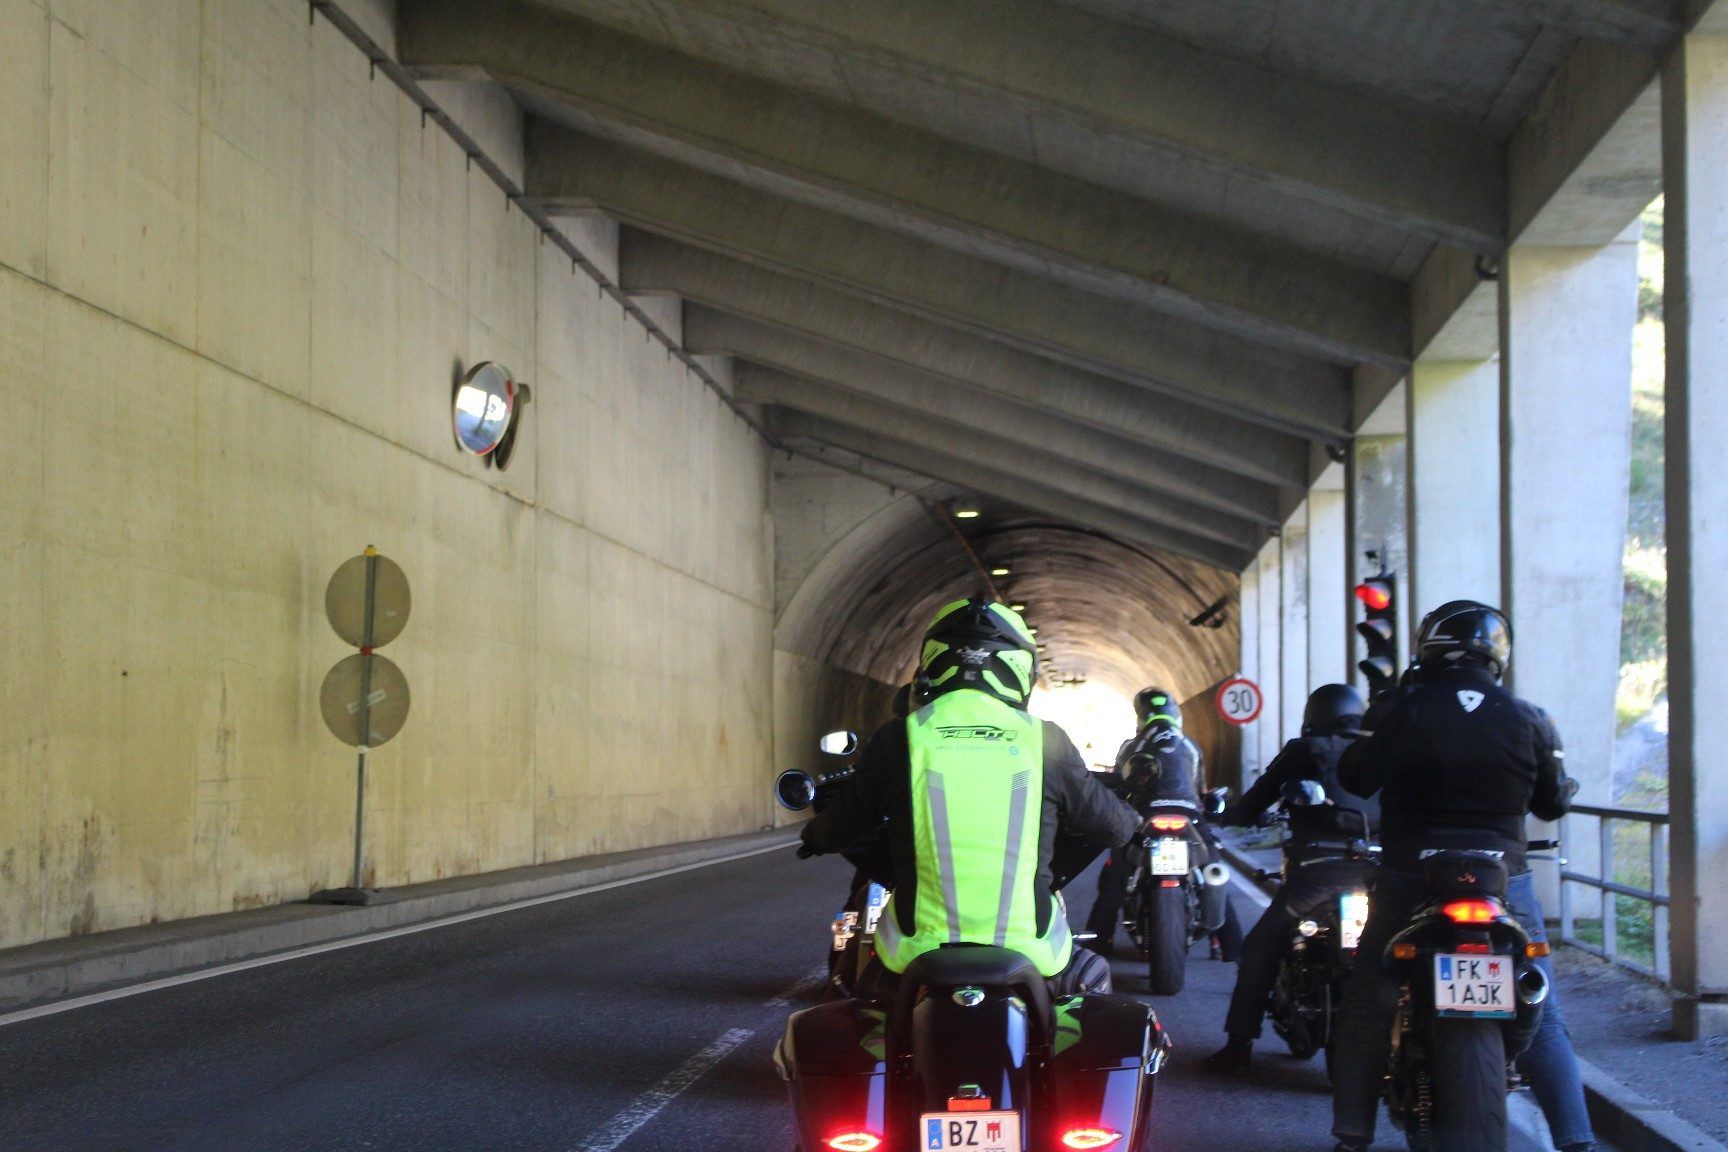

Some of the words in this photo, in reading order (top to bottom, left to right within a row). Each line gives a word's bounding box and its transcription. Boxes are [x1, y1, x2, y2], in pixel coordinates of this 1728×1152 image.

[1227, 689, 1253, 714] 30
[1457, 960, 1481, 980] FK
[949, 1120, 979, 1147] BZ
